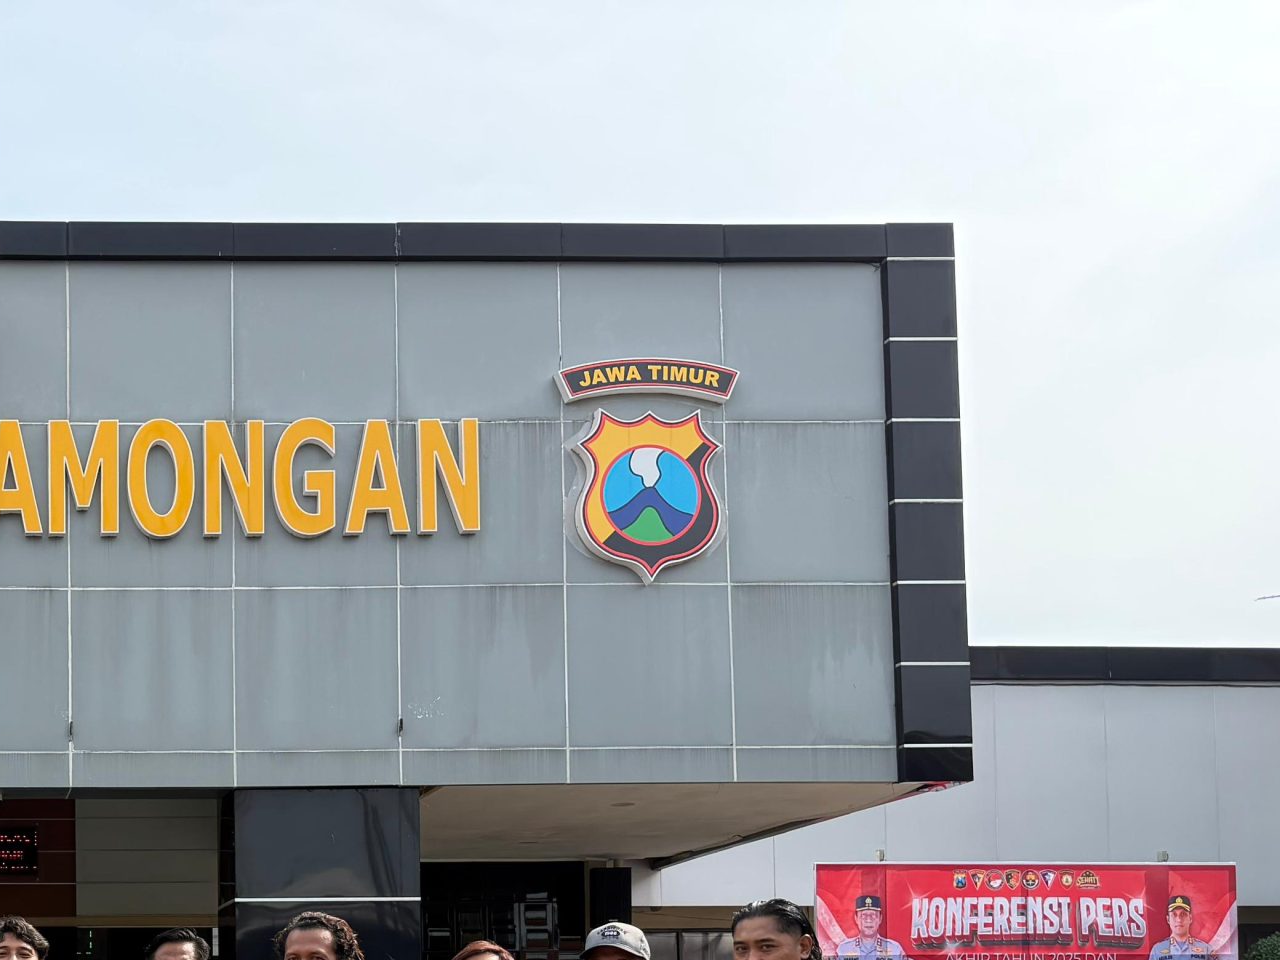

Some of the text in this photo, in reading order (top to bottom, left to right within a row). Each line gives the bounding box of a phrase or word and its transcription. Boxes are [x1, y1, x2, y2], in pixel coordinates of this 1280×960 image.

[579, 365, 720, 387] JAWA TIMUR
[910, 896, 1147, 941] KONFERENSI PERS
